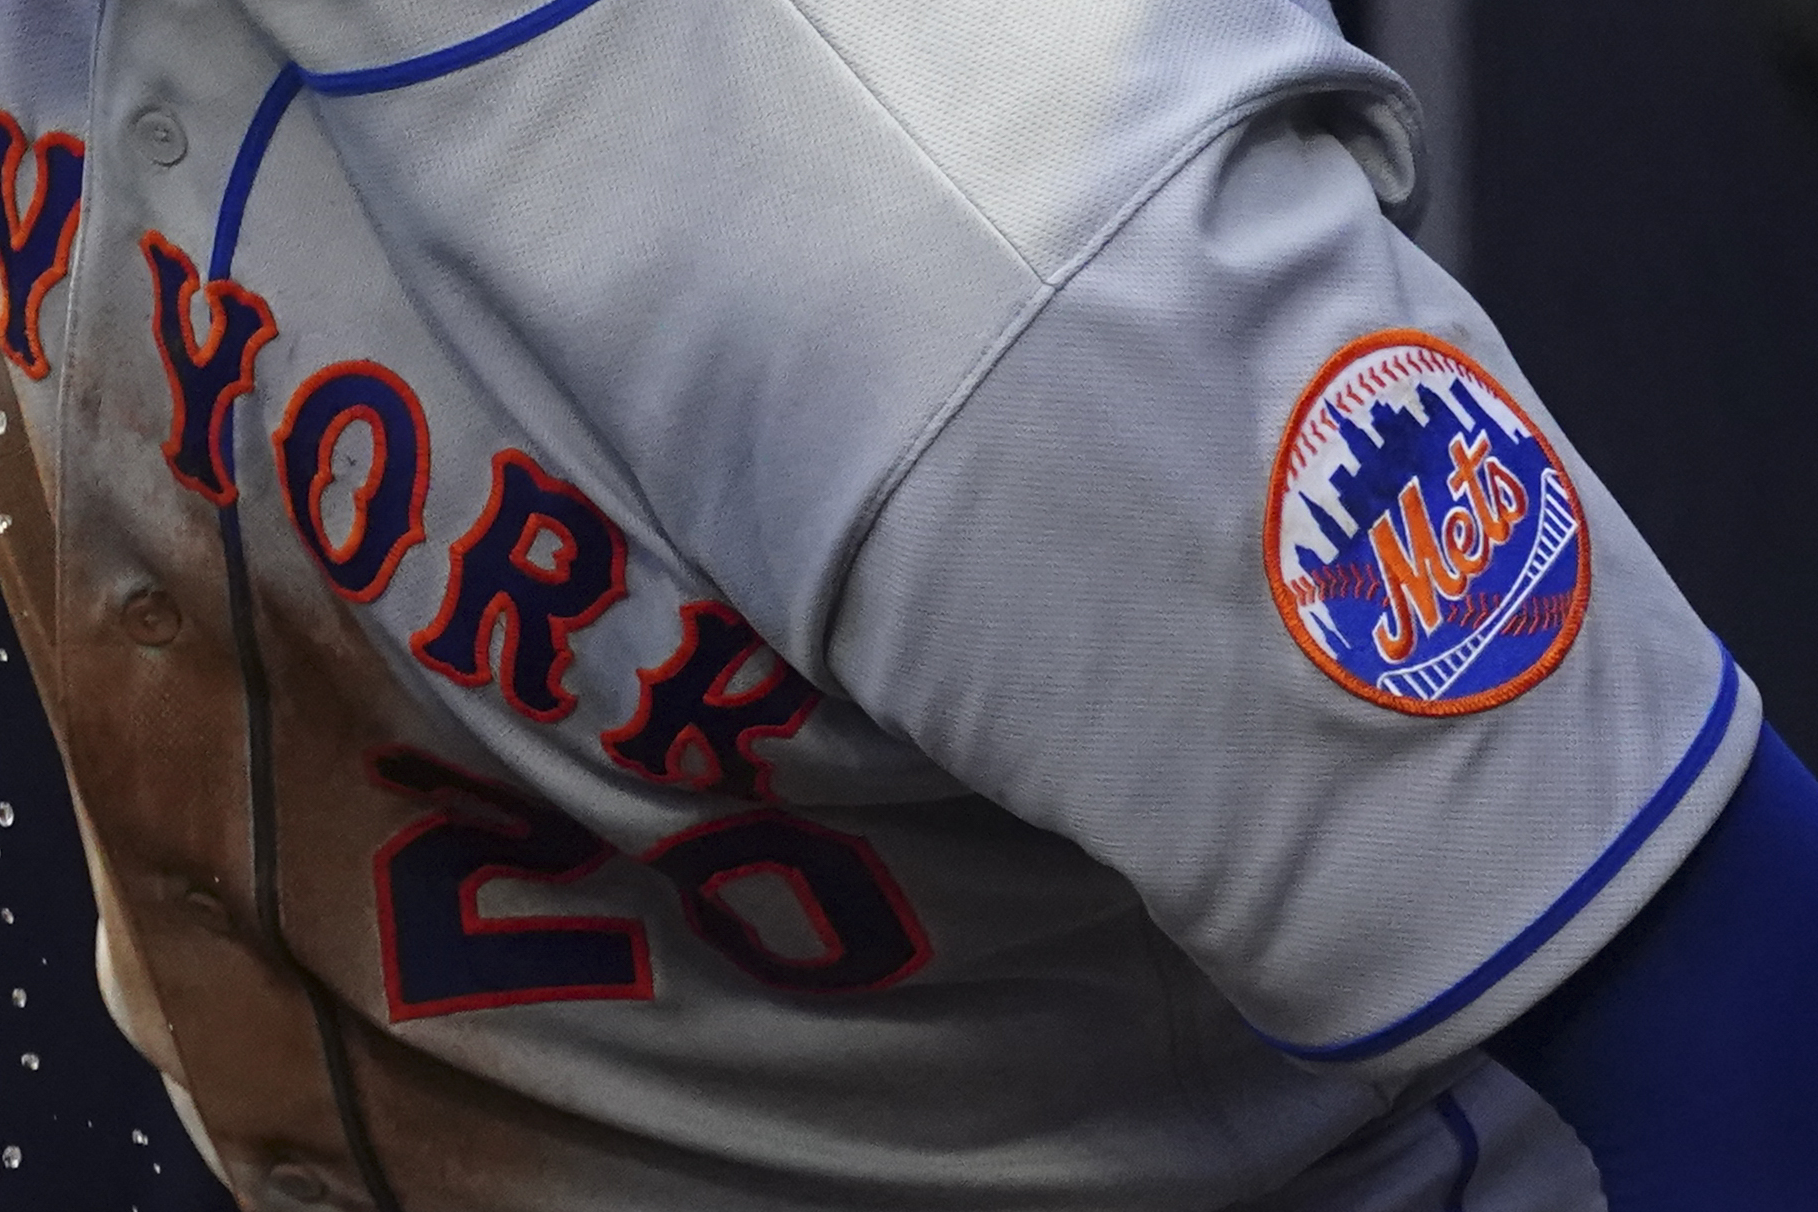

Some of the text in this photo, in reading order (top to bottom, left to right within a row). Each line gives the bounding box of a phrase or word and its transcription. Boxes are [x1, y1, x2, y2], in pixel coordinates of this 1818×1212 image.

[140, 230, 820, 801] YORK
[1369, 430, 1528, 662] Mets
[364, 743, 935, 1024] 20
